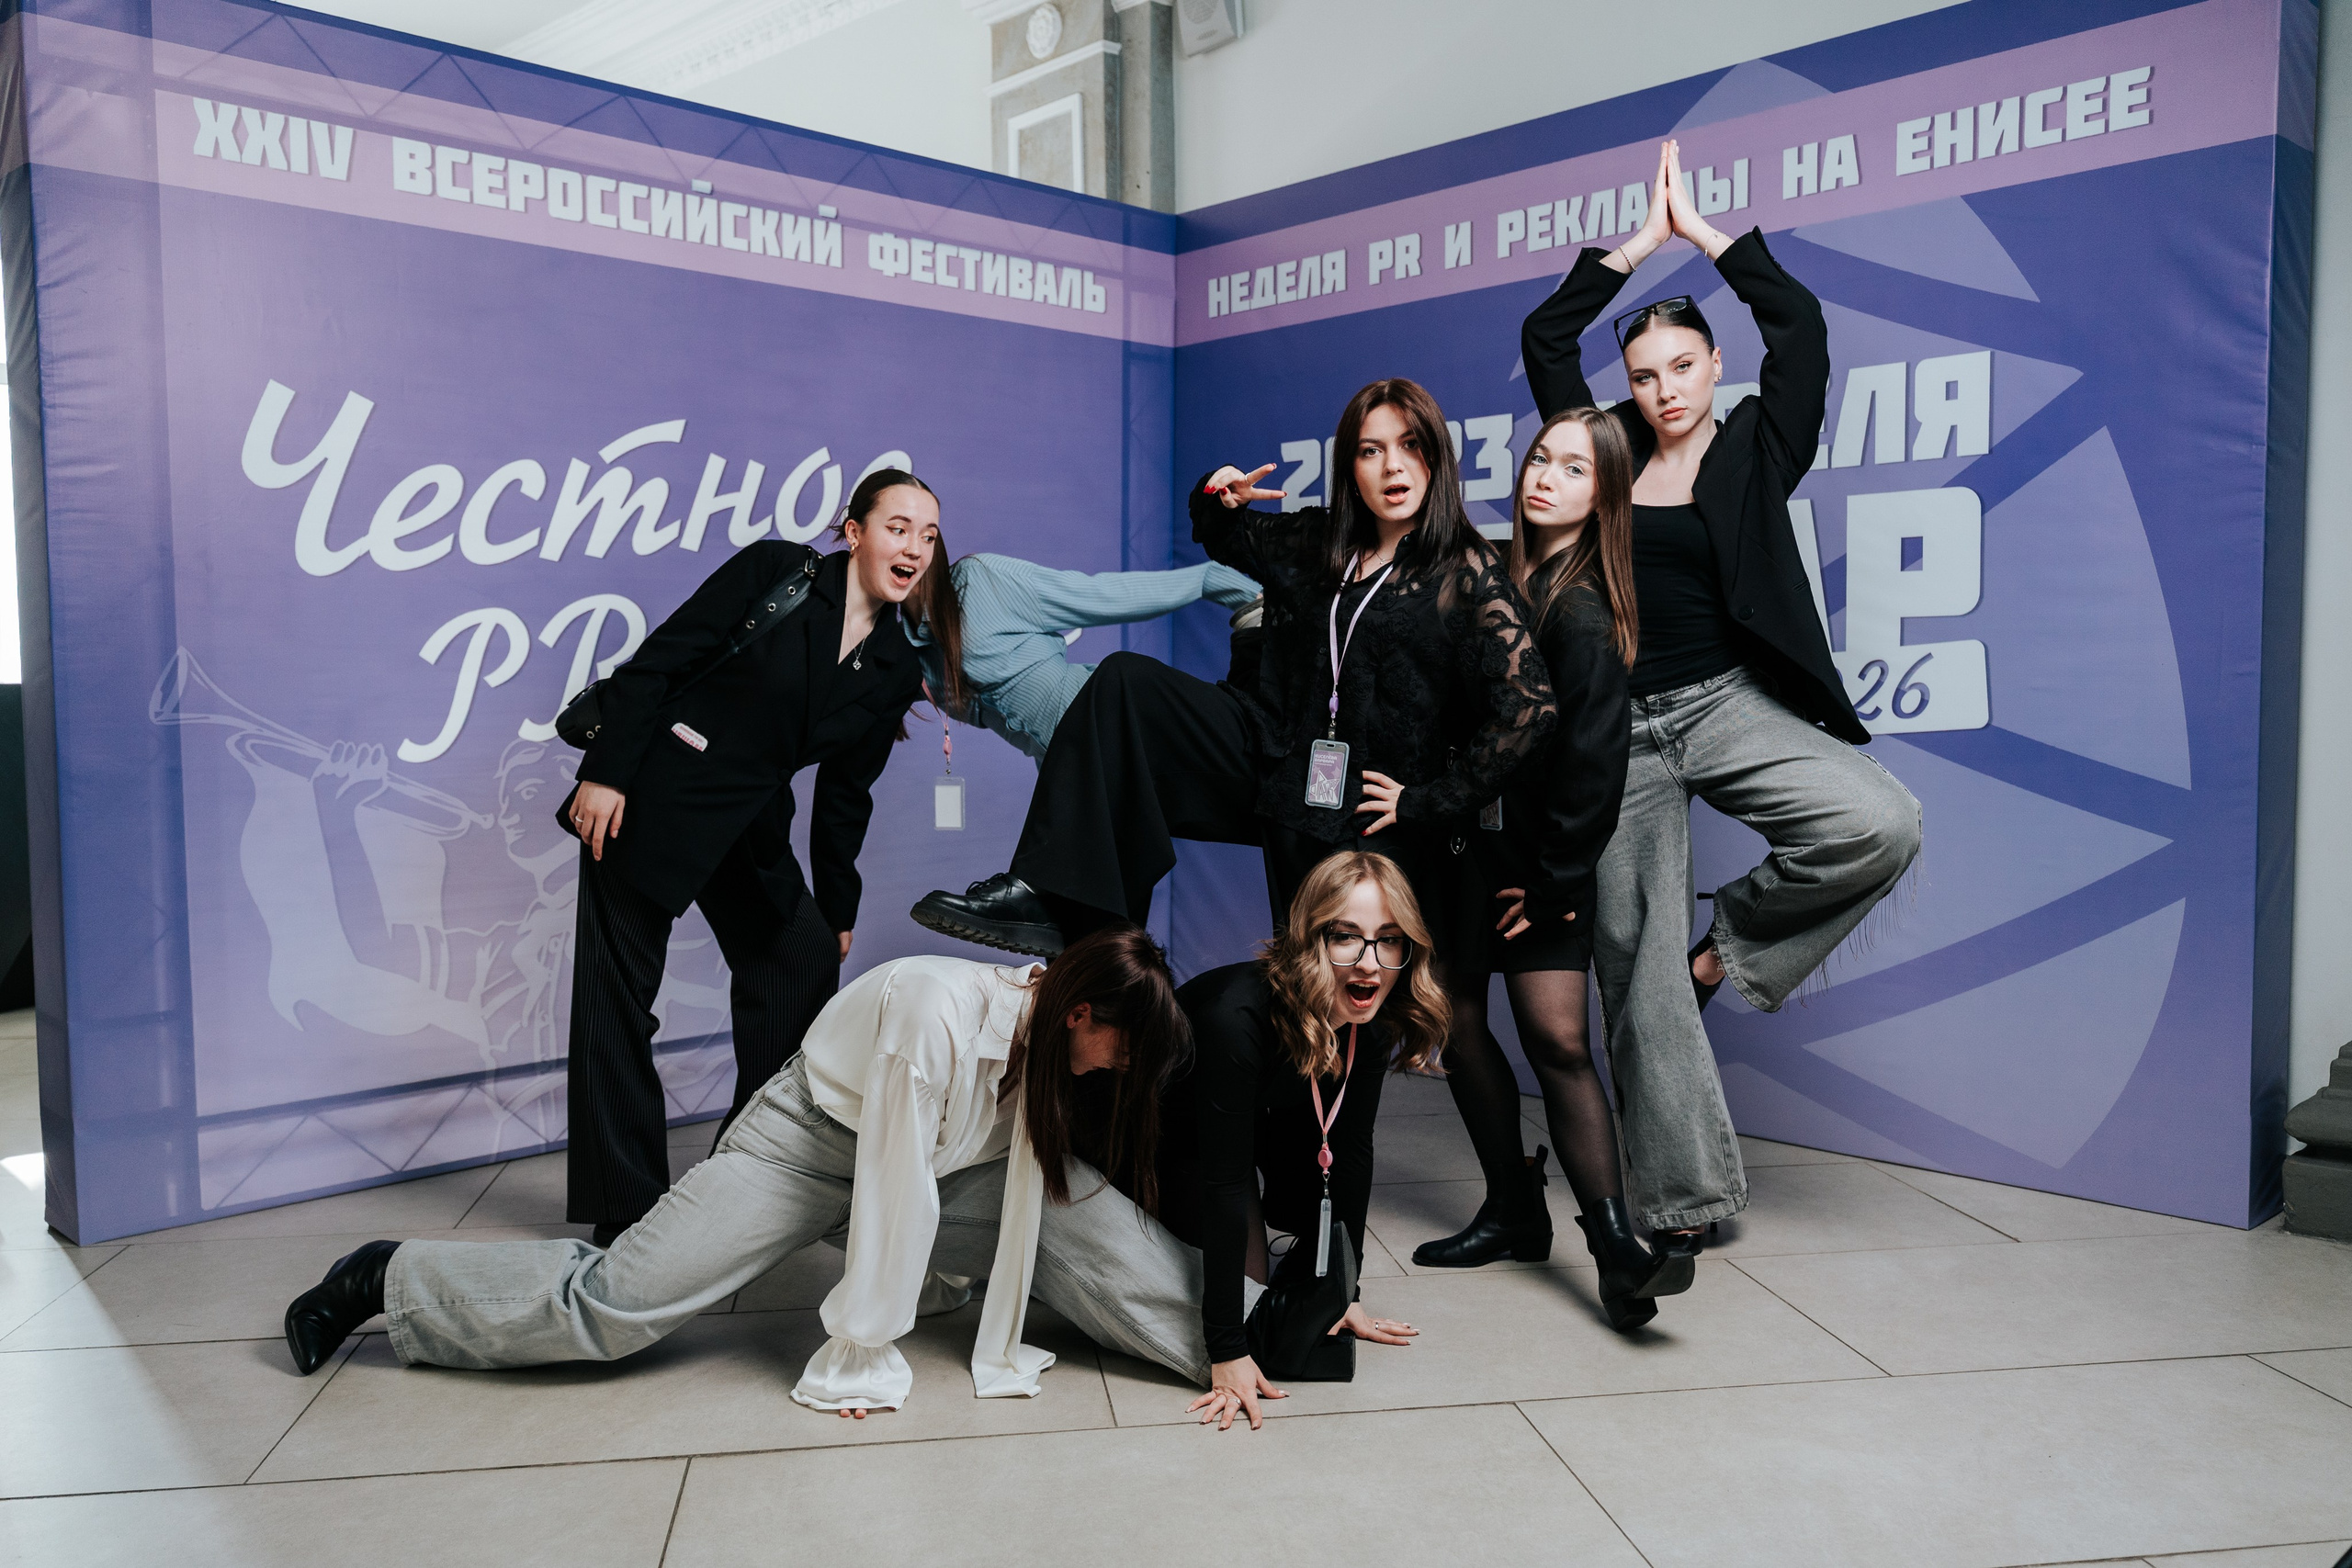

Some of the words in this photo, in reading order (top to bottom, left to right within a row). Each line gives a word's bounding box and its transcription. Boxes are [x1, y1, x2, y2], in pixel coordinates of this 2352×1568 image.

[193, 96, 354, 181] XXIV
[392, 136, 842, 267] ВСЕРОССИЙСКИЙ
[868, 231, 1106, 313] ФЕСТИВАЛЬ
[1208, 249, 1347, 318] НЕДЕЛЯ
[1368, 232, 1421, 285] PR
[1444, 220, 1473, 269] И
[1498, 158, 1749, 259] РЕКЛАЫ
[1782, 133, 1860, 200] НА
[1896, 66, 2152, 176] ЕНИСЕЕ
